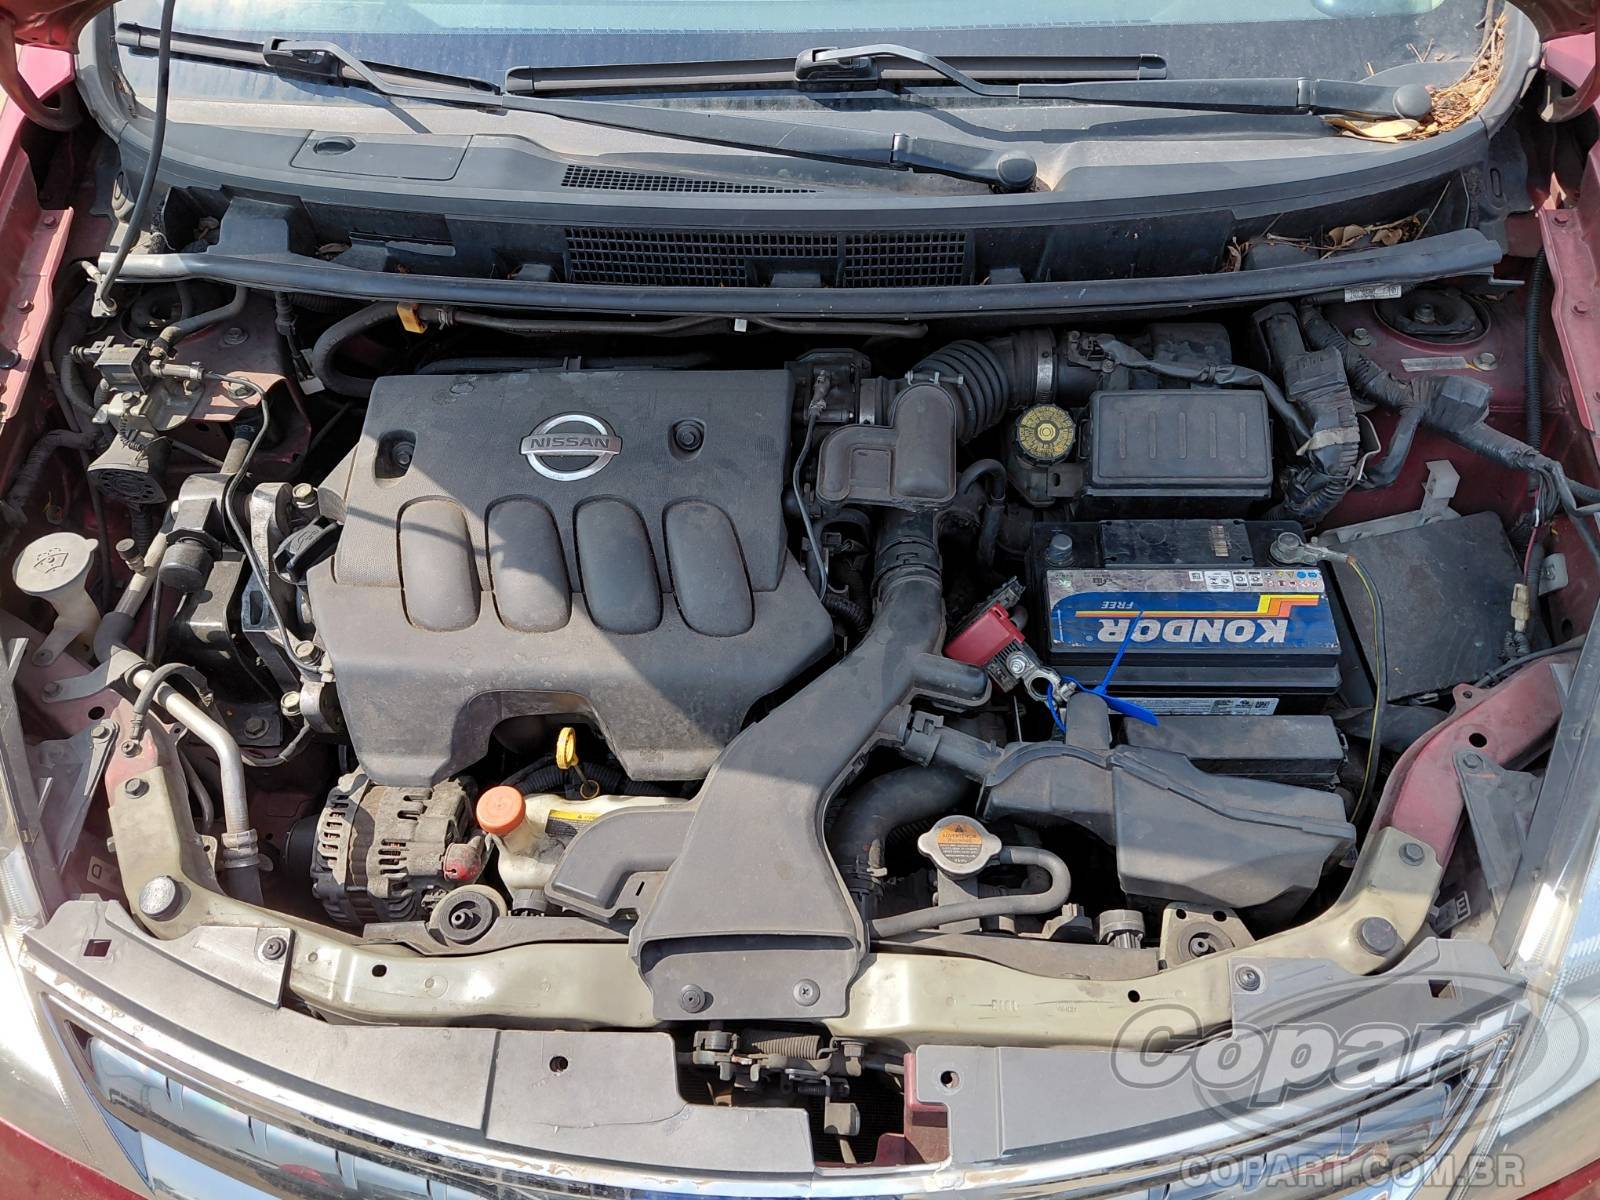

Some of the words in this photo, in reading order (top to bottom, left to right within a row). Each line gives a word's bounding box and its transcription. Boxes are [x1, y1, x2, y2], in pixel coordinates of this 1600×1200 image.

[530, 436, 610, 449] NISSAN
[1100, 600, 1135, 609] FREE
[1097, 619, 1289, 643] KONDOR
